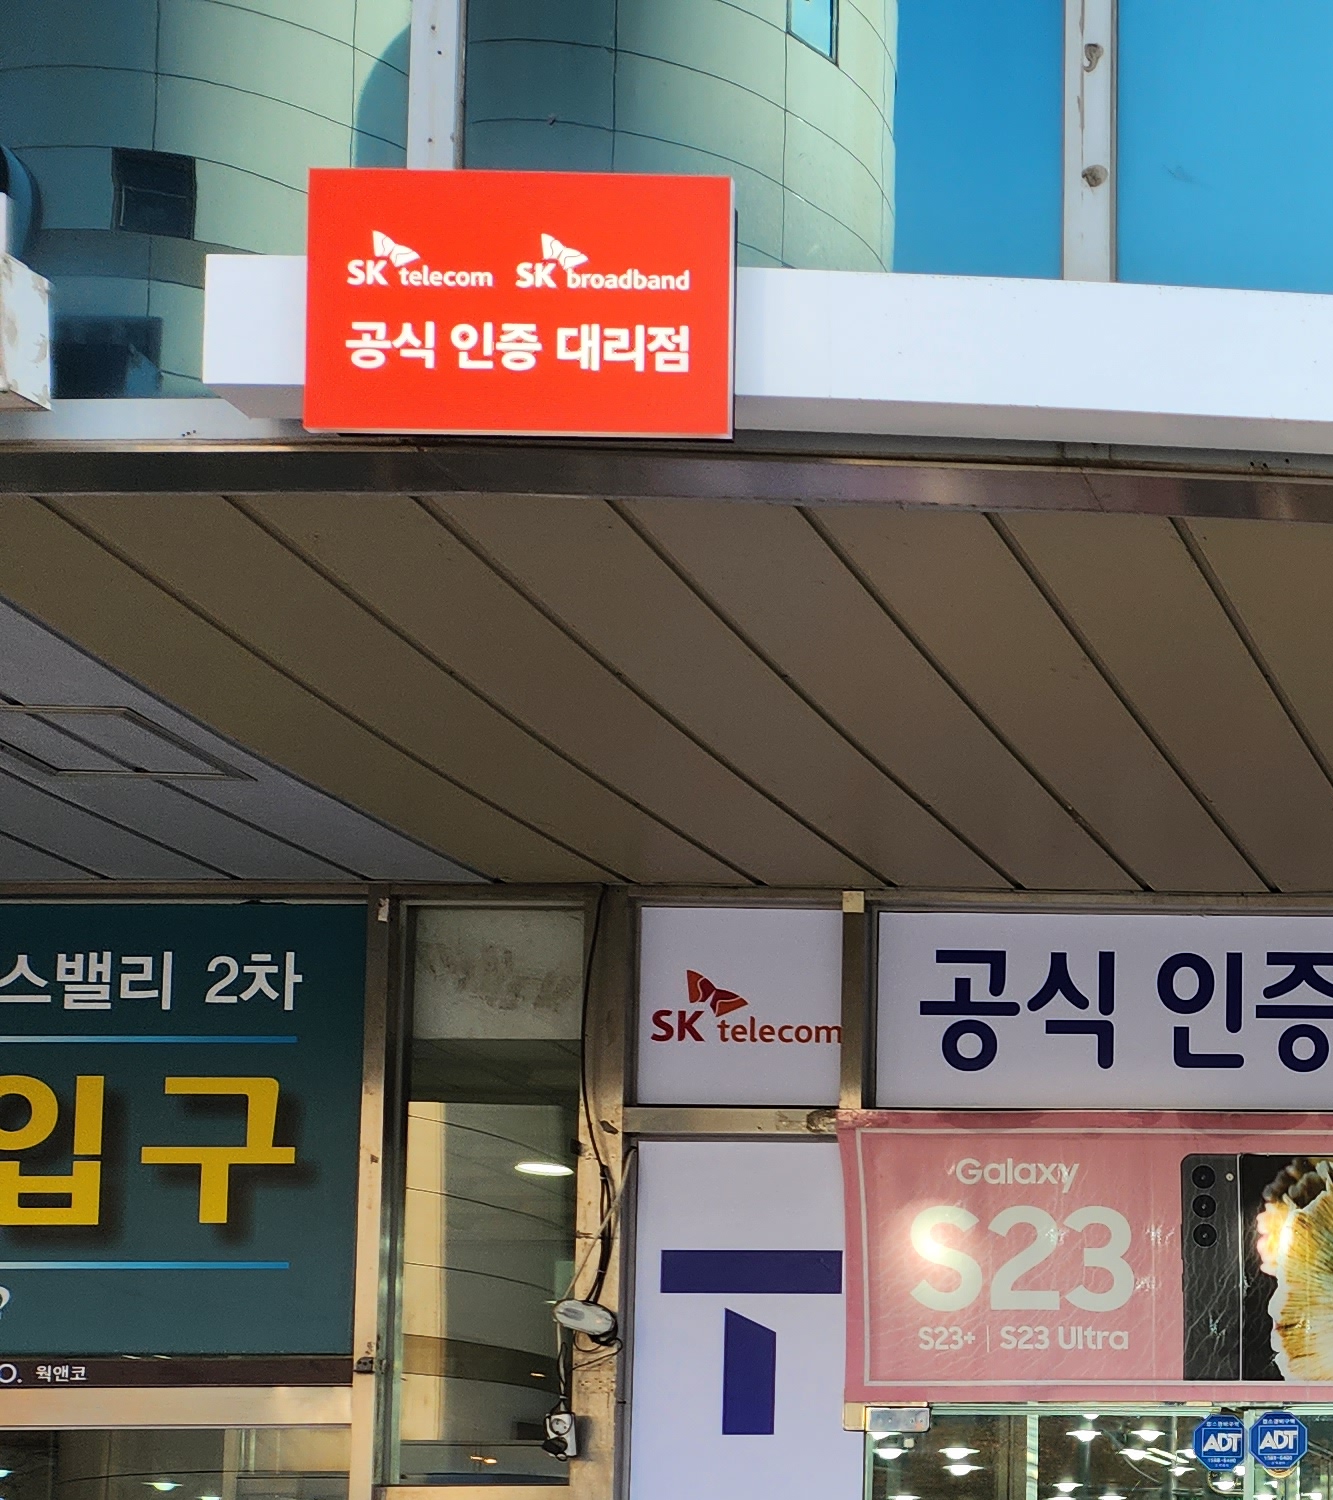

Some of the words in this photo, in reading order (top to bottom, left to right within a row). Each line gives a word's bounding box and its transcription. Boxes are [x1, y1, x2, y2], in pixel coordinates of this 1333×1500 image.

[346, 259, 389, 287] SK
[399, 266, 494, 288] telecom
[515, 261, 558, 290] SK
[566, 267, 690, 291] broadband
[345, 321, 435, 370] 공식
[450, 323, 542, 372] 인증
[556, 324, 690, 374] 대리점
[0, 951, 174, 1011] 스밸리
[204, 951, 303, 1011] 2차
[650, 1009, 706, 1042] SK
[717, 1018, 843, 1045] telecom
[919, 949, 1117, 1072] 공식
[0, 1074, 297, 1225] 입구
[955, 1158, 1080, 1194] Galaxy
[910, 1205, 1134, 1312] S23
[918, 1327, 977, 1351] S23+
[1000, 1326, 1050, 1351] S23
[1057, 1325, 1130, 1351] Ultra
[35, 1363, 87, 1383] 웍앤코
[1203, 1432, 1242, 1452] ADT
[1259, 1430, 1298, 1450] ADT
